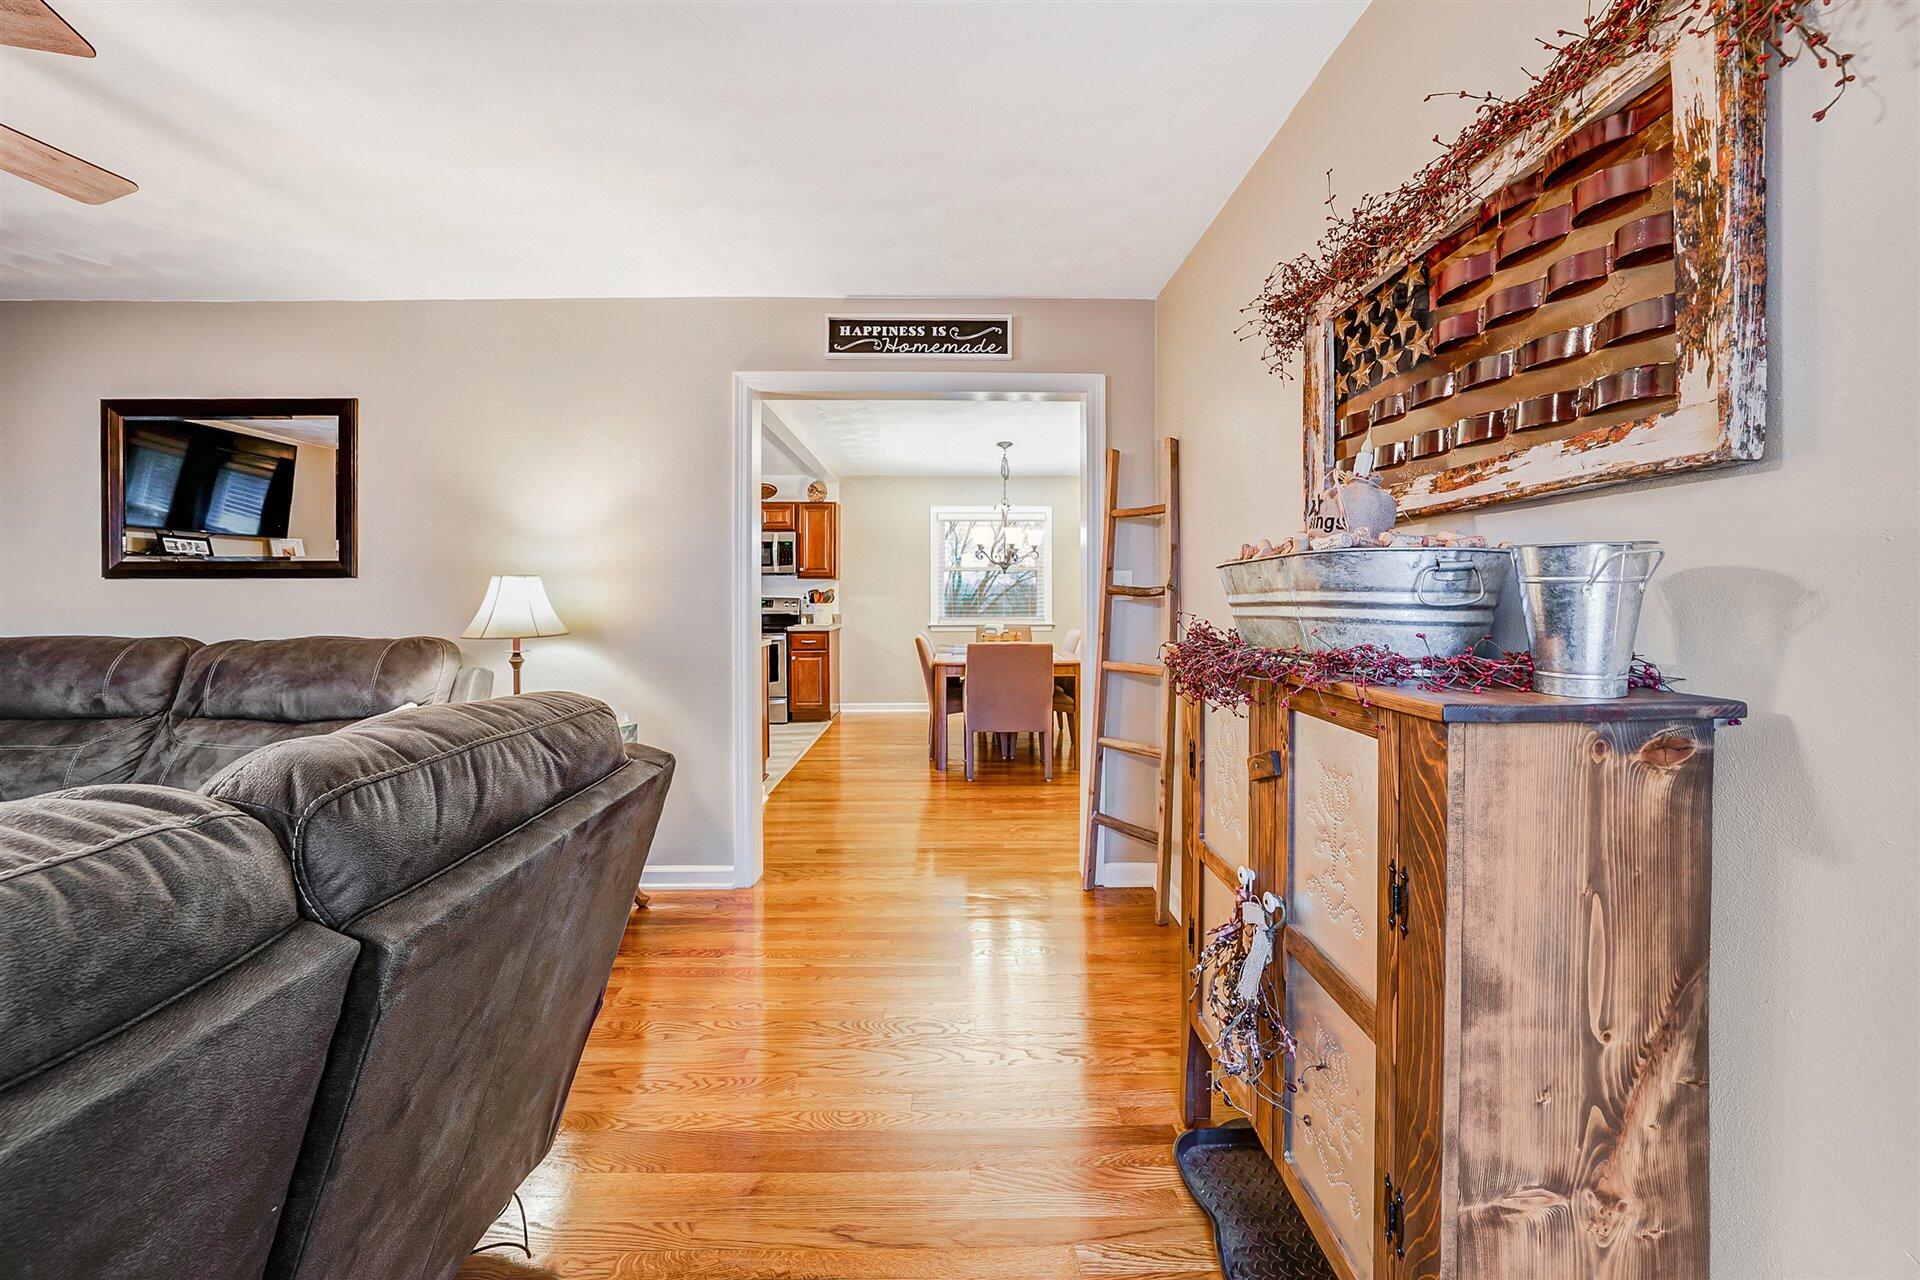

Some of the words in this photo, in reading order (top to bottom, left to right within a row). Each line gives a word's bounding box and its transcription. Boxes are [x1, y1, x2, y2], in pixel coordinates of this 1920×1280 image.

[839, 325, 926, 337] HAPPINESS
[931, 325, 947, 337] IS
[881, 337, 1002, 353] Homemade
